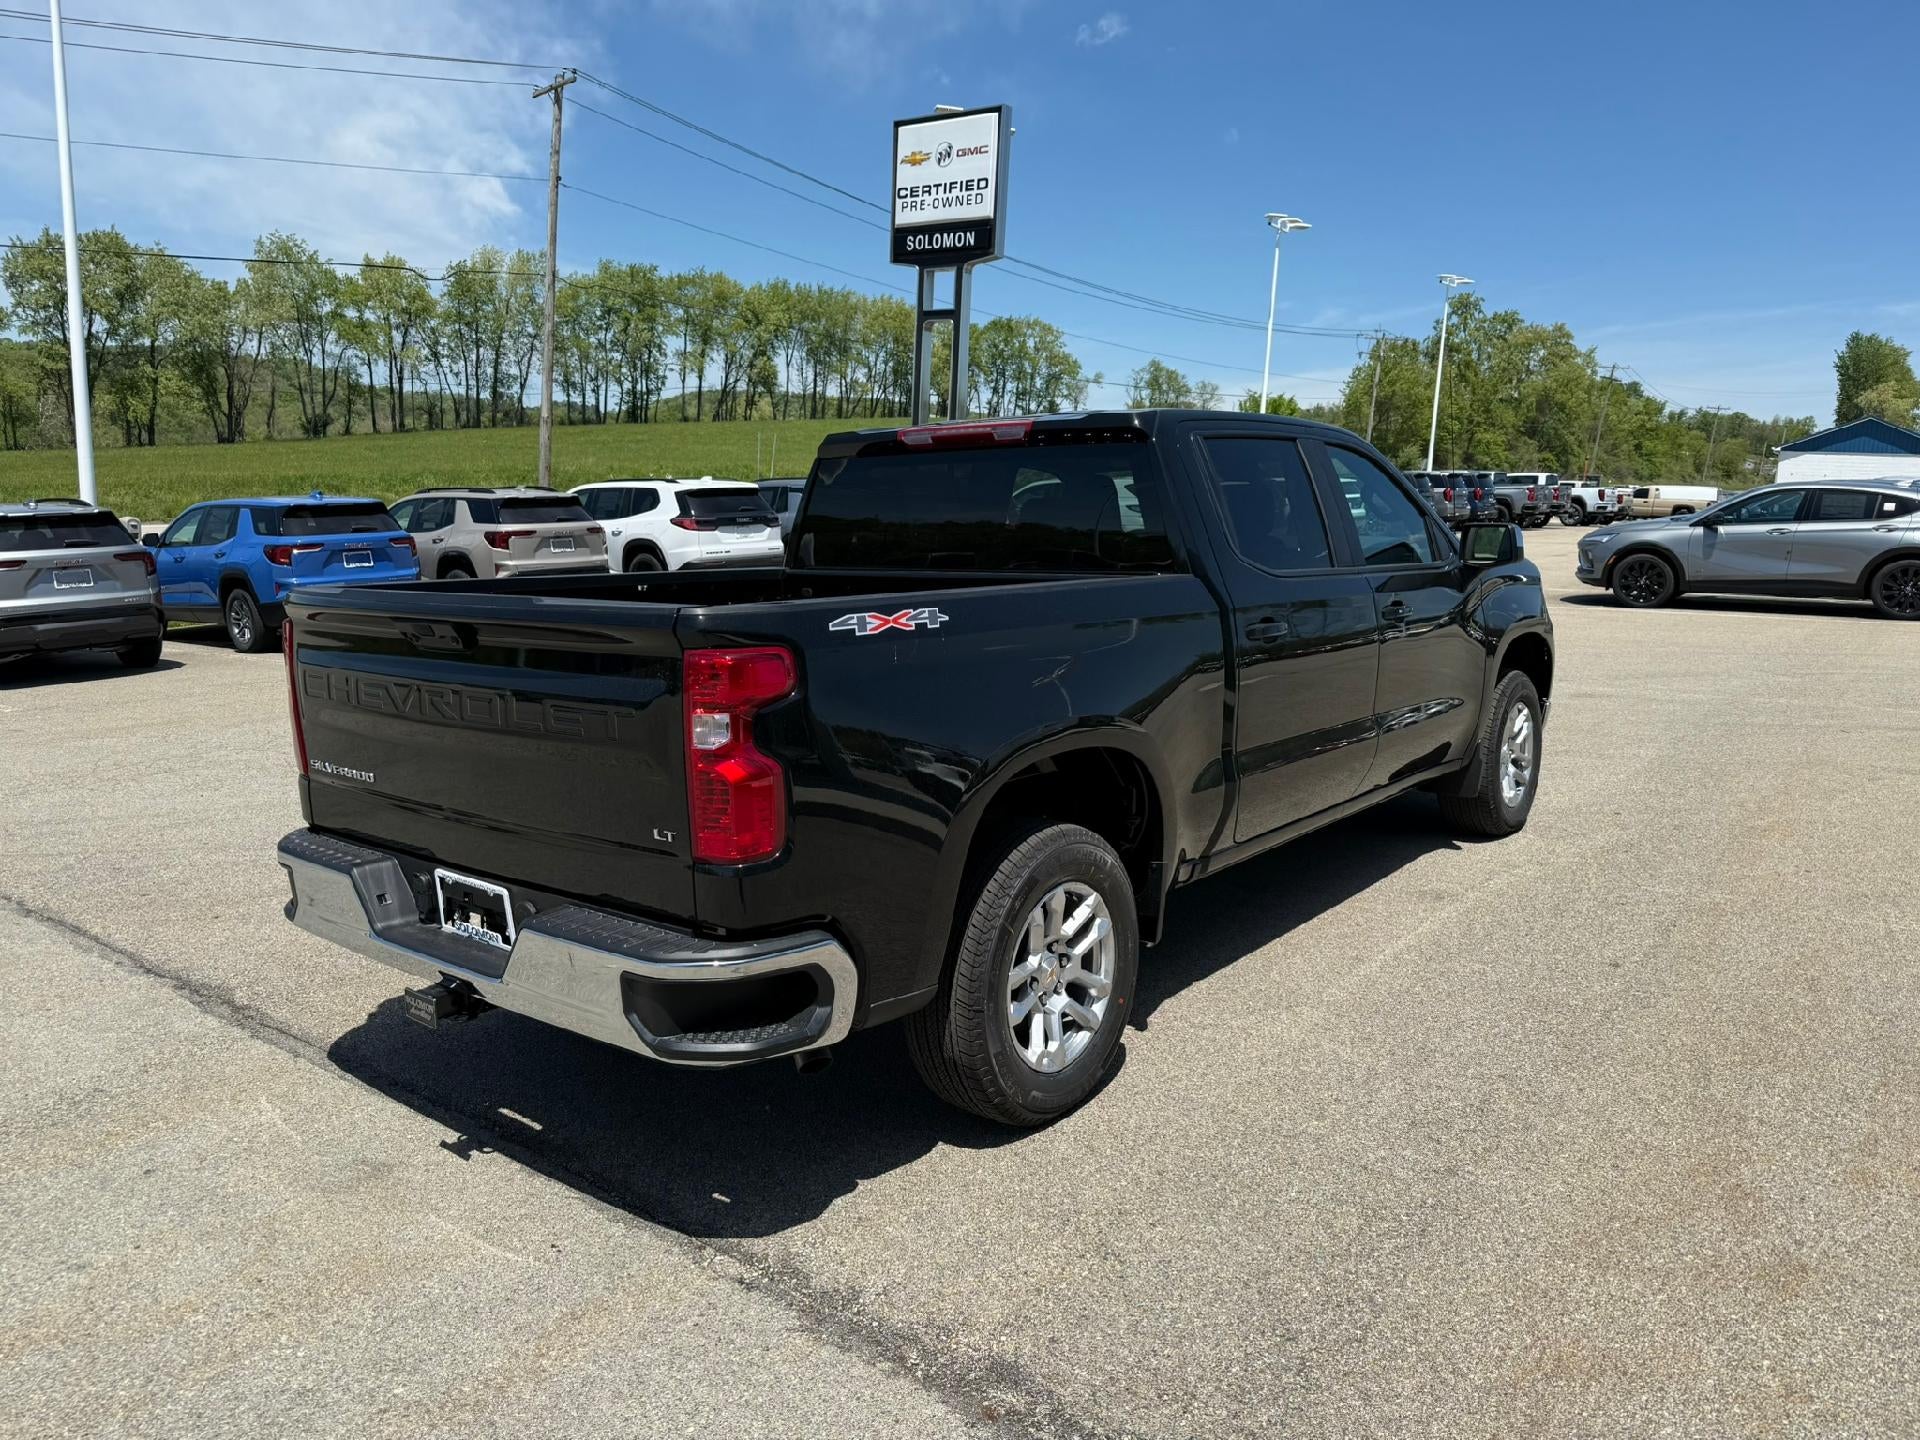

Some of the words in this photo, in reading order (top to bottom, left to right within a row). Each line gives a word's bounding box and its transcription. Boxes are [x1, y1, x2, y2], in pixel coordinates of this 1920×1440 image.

[956, 145, 989, 158] GMC
[897, 177, 989, 200] CERTIFIED
[901, 192, 984, 213] PRE-OWNED
[906, 231, 975, 251] SOLOMON
[302, 668, 637, 743] CHEVROLET
[310, 759, 375, 783] SILVERADO
[653, 828, 677, 843] LT
[455, 920, 500, 945] SOLOMON
